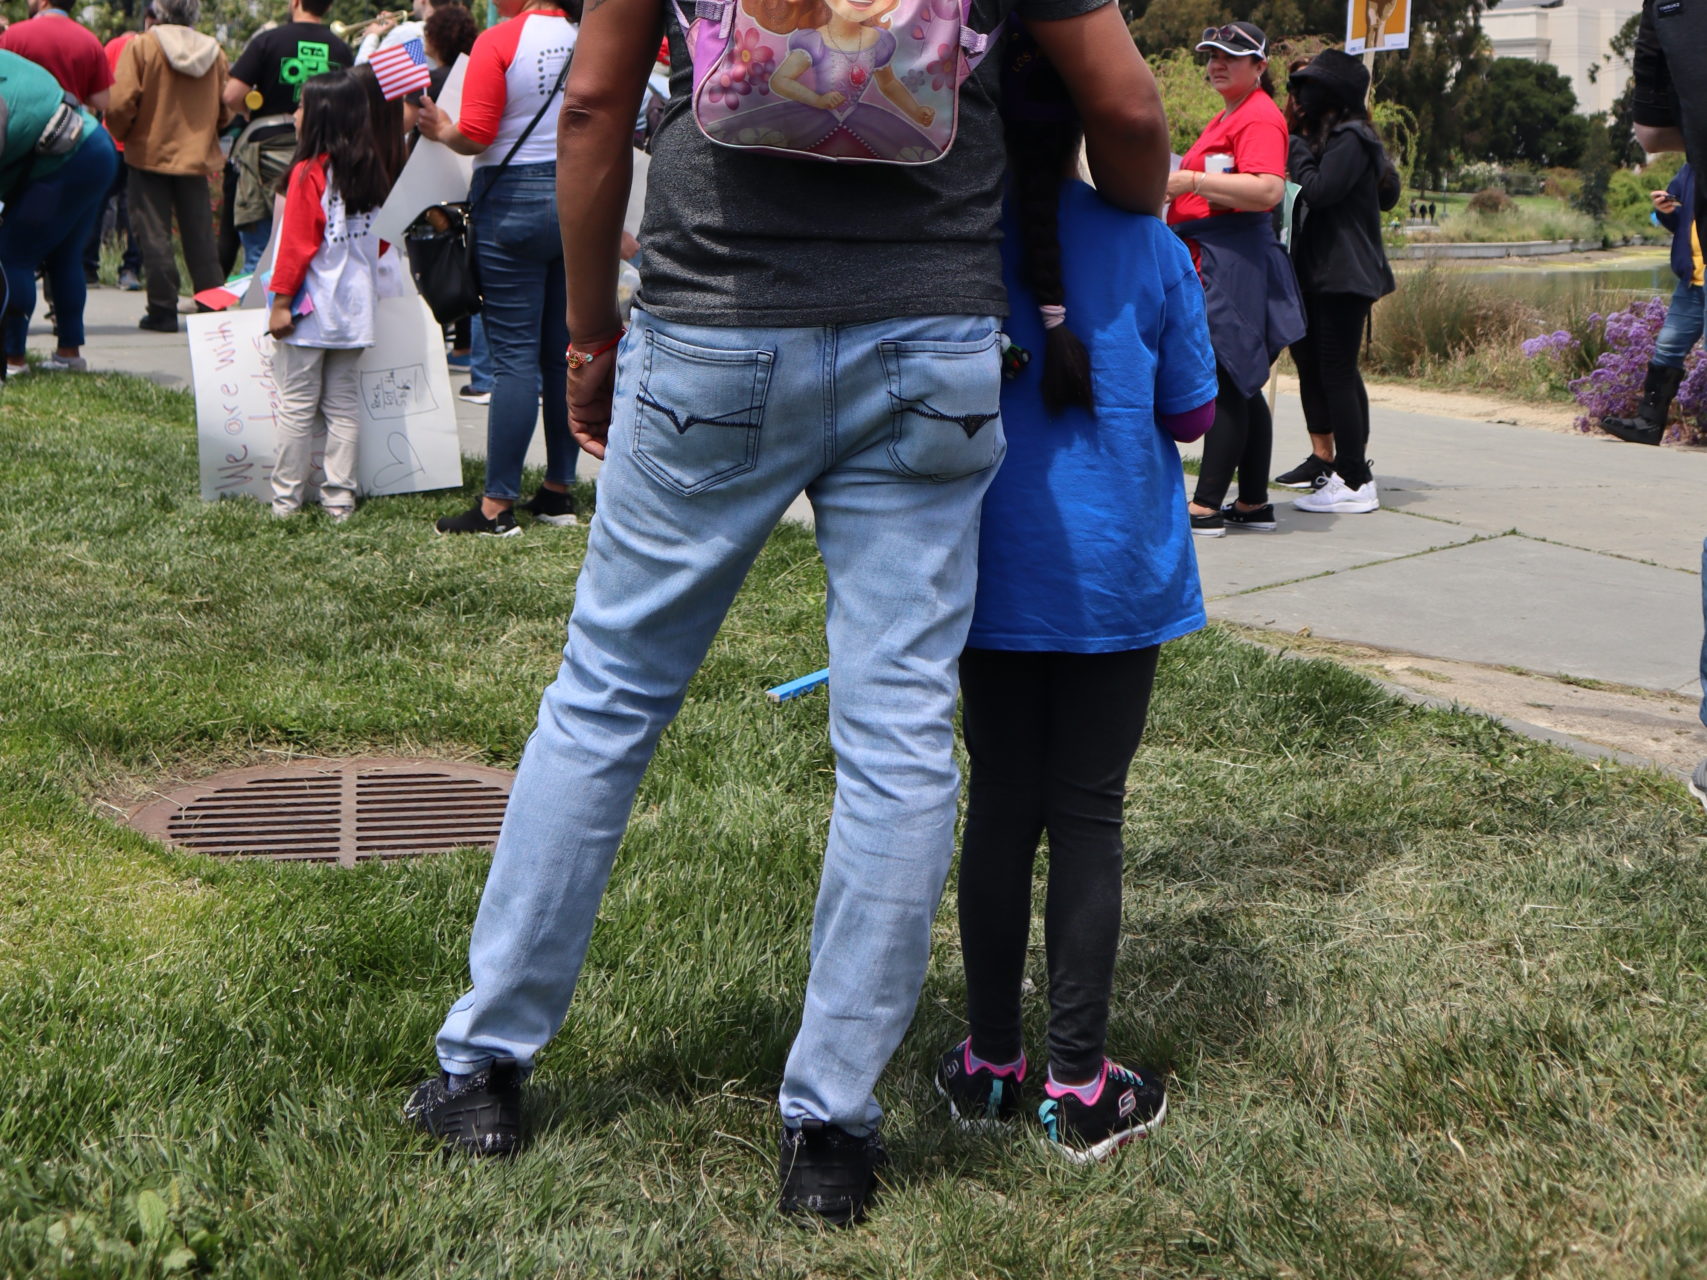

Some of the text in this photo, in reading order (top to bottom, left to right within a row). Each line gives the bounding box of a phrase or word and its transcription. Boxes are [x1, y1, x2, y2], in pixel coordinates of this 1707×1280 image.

[204, 320, 254, 491] We are with
